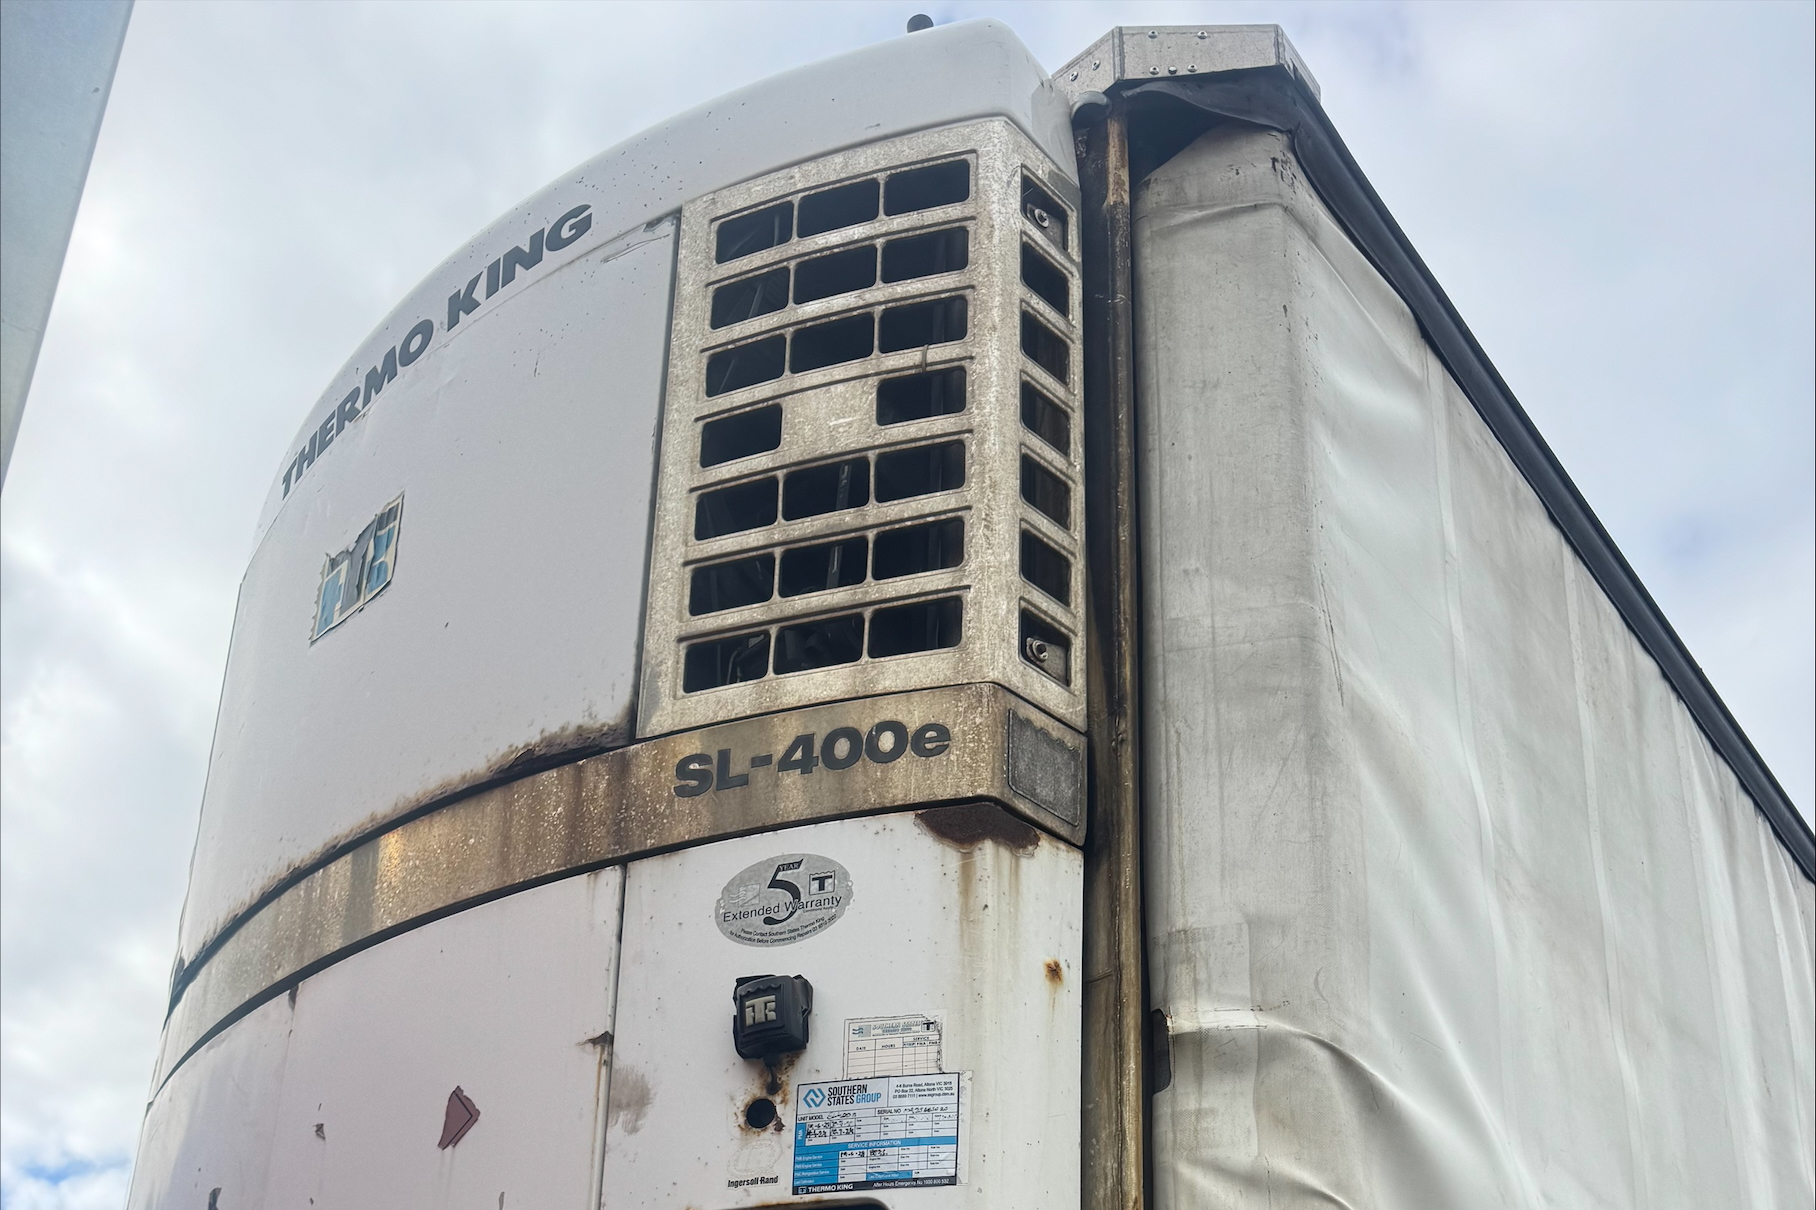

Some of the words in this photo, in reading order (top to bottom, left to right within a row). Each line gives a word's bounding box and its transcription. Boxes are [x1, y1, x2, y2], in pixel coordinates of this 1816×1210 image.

[281, 319, 434, 501] THERMO
[446, 203, 594, 332] KING
[673, 721, 951, 798] SL-400e
[723, 903, 781, 923] Extended
[785, 895, 843, 912] Warranty
[827, 1084, 868, 1097] SOUTHERN
[827, 1095, 855, 1106] STATES
[856, 1093, 882, 1104] GROUP
[868, 1140, 901, 1148] INFORMATION
[808, 1185, 837, 1193] THERMO
[837, 1183, 854, 1191] KING
